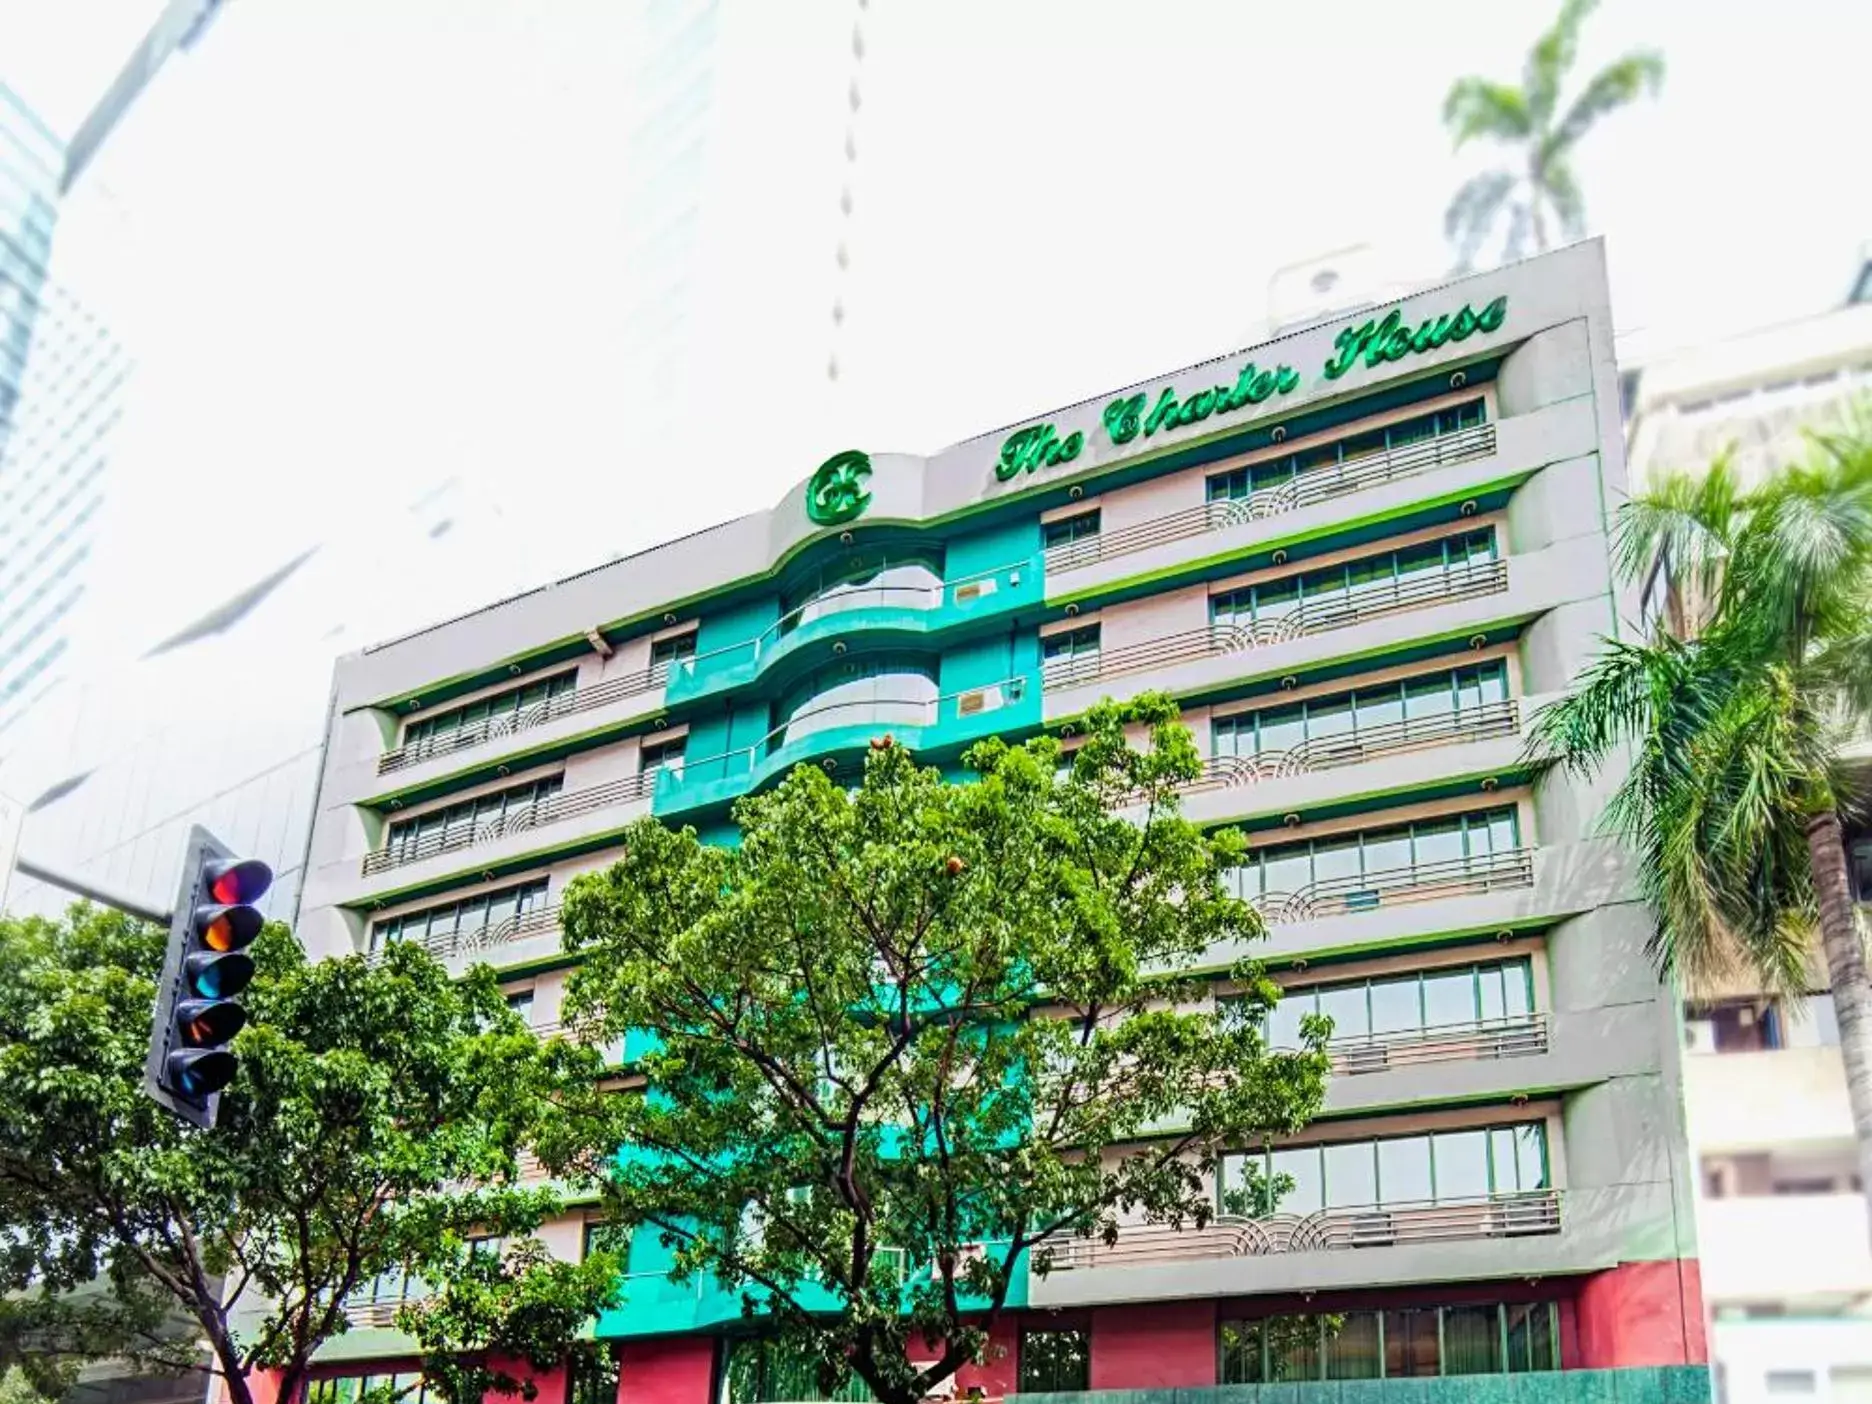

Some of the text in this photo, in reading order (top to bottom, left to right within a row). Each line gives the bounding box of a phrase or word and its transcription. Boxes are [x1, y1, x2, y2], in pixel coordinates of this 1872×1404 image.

[996, 295, 1508, 482] The Charter House
